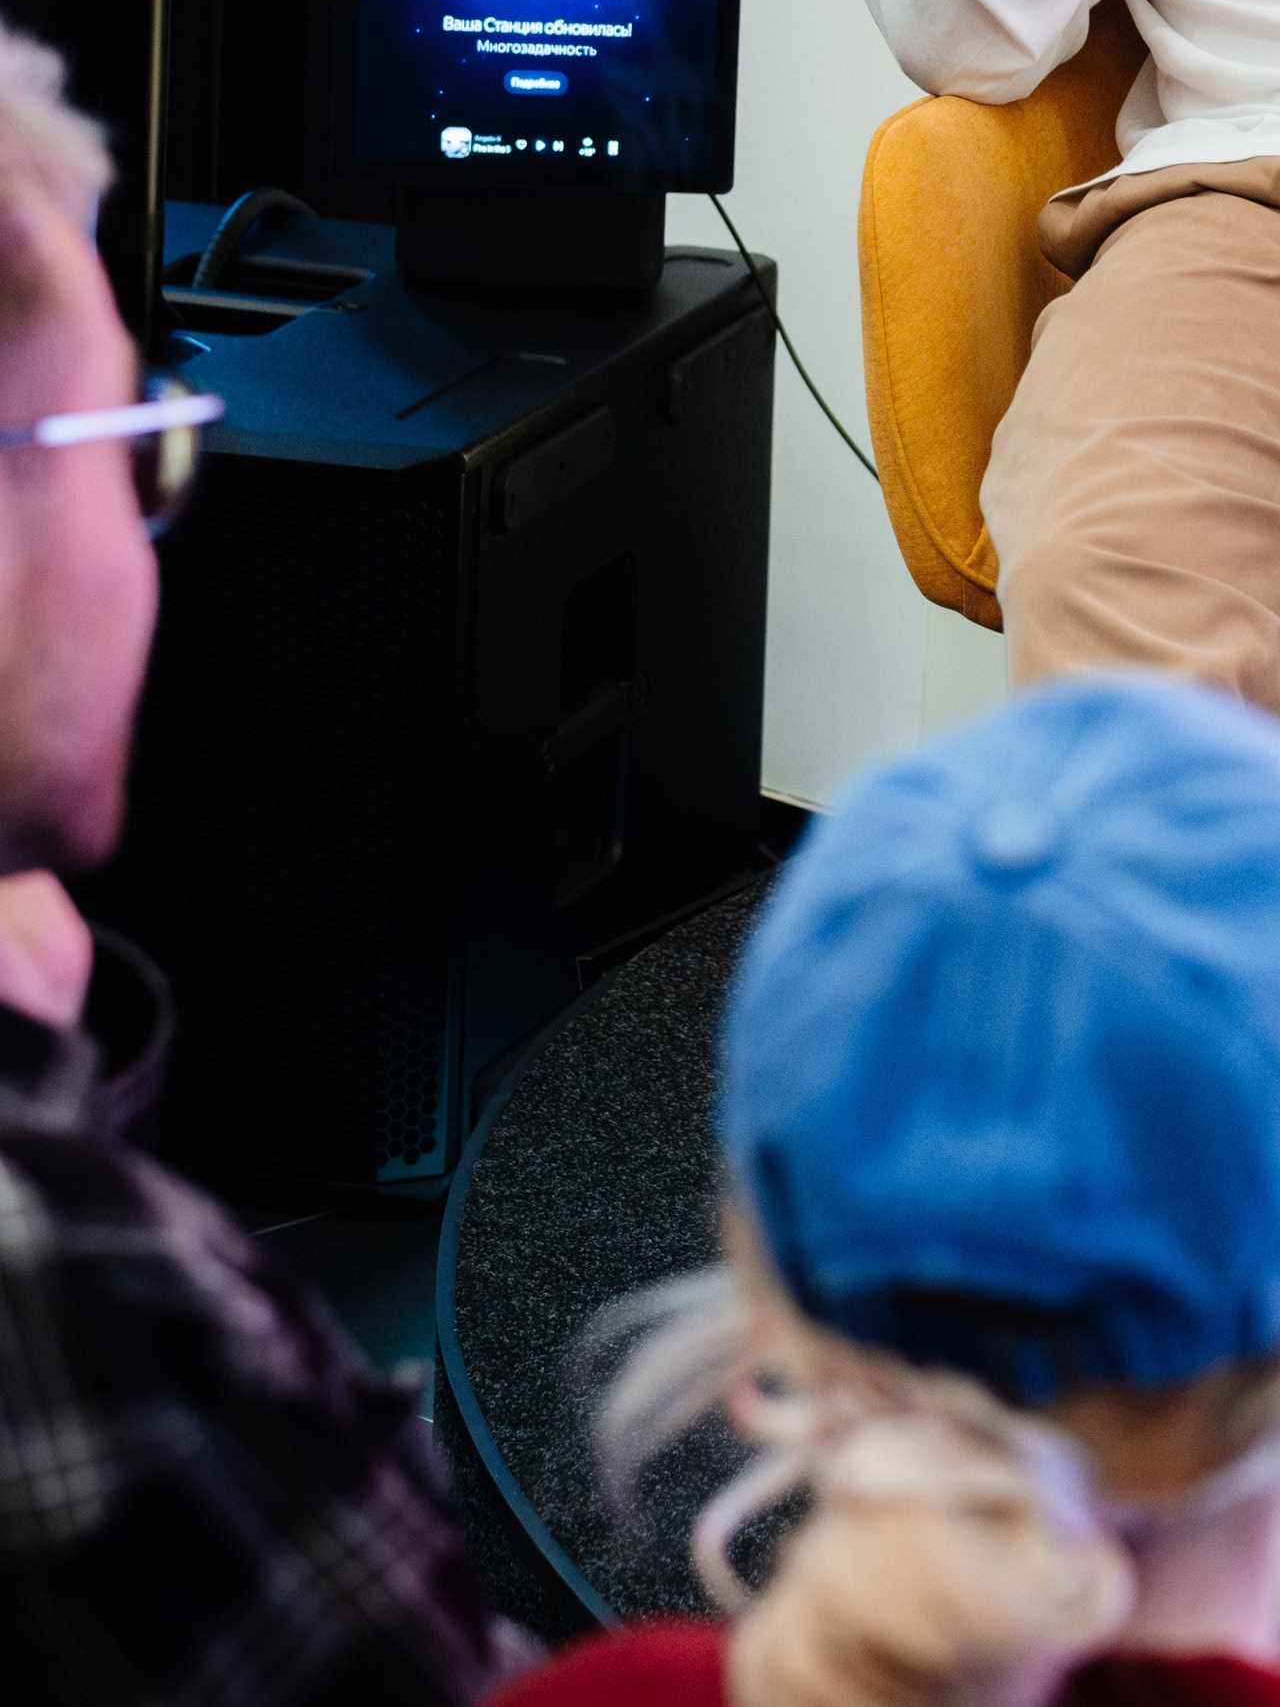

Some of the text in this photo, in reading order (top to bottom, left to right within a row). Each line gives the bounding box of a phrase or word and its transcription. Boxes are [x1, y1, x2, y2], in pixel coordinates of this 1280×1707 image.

[442, 15, 632, 38] Ваша Станция обновилась!
[476, 39, 598, 58] Многозадачность
